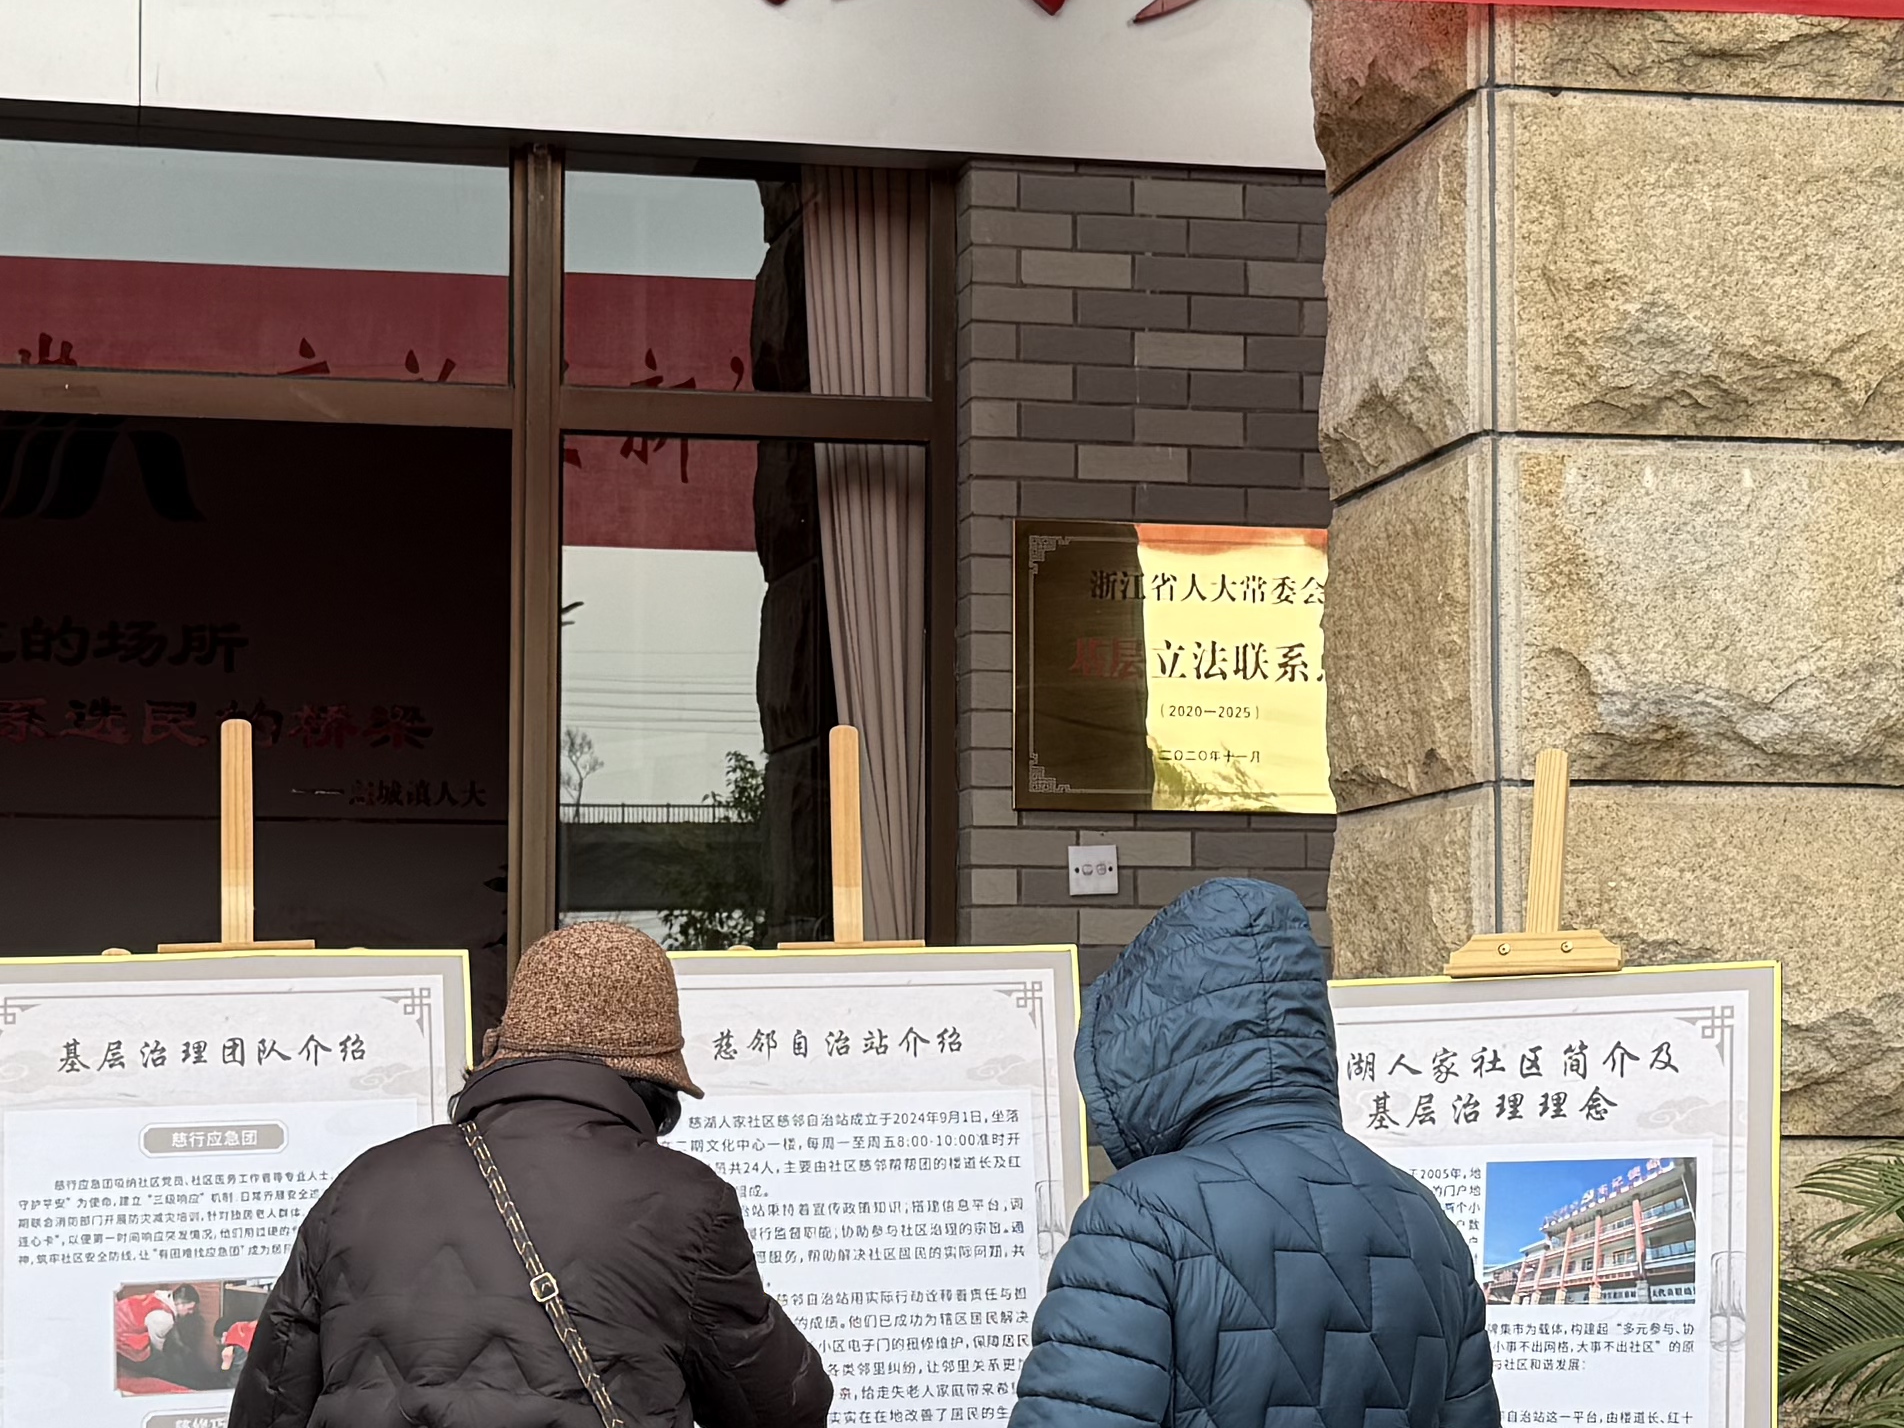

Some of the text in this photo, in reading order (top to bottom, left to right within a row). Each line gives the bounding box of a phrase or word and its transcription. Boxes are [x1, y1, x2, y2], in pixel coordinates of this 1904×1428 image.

[1091, 570, 1325, 606] 浙江省人大常委会
[1071, 637, 1325, 683] 基层立法联系
[57, 1033, 367, 1074] 基层治理团队介绍
[711, 1025, 964, 1061] 慈邻自治站介绍
[1347, 1039, 1680, 1084] 湖人家社区简介及
[1367, 1086, 1618, 1131] 基层治理理念
[171, 1128, 258, 1149] 慈行应急团
[1502, 1410, 1694, 1425] 自治站这一平台，由楼道长、红十
